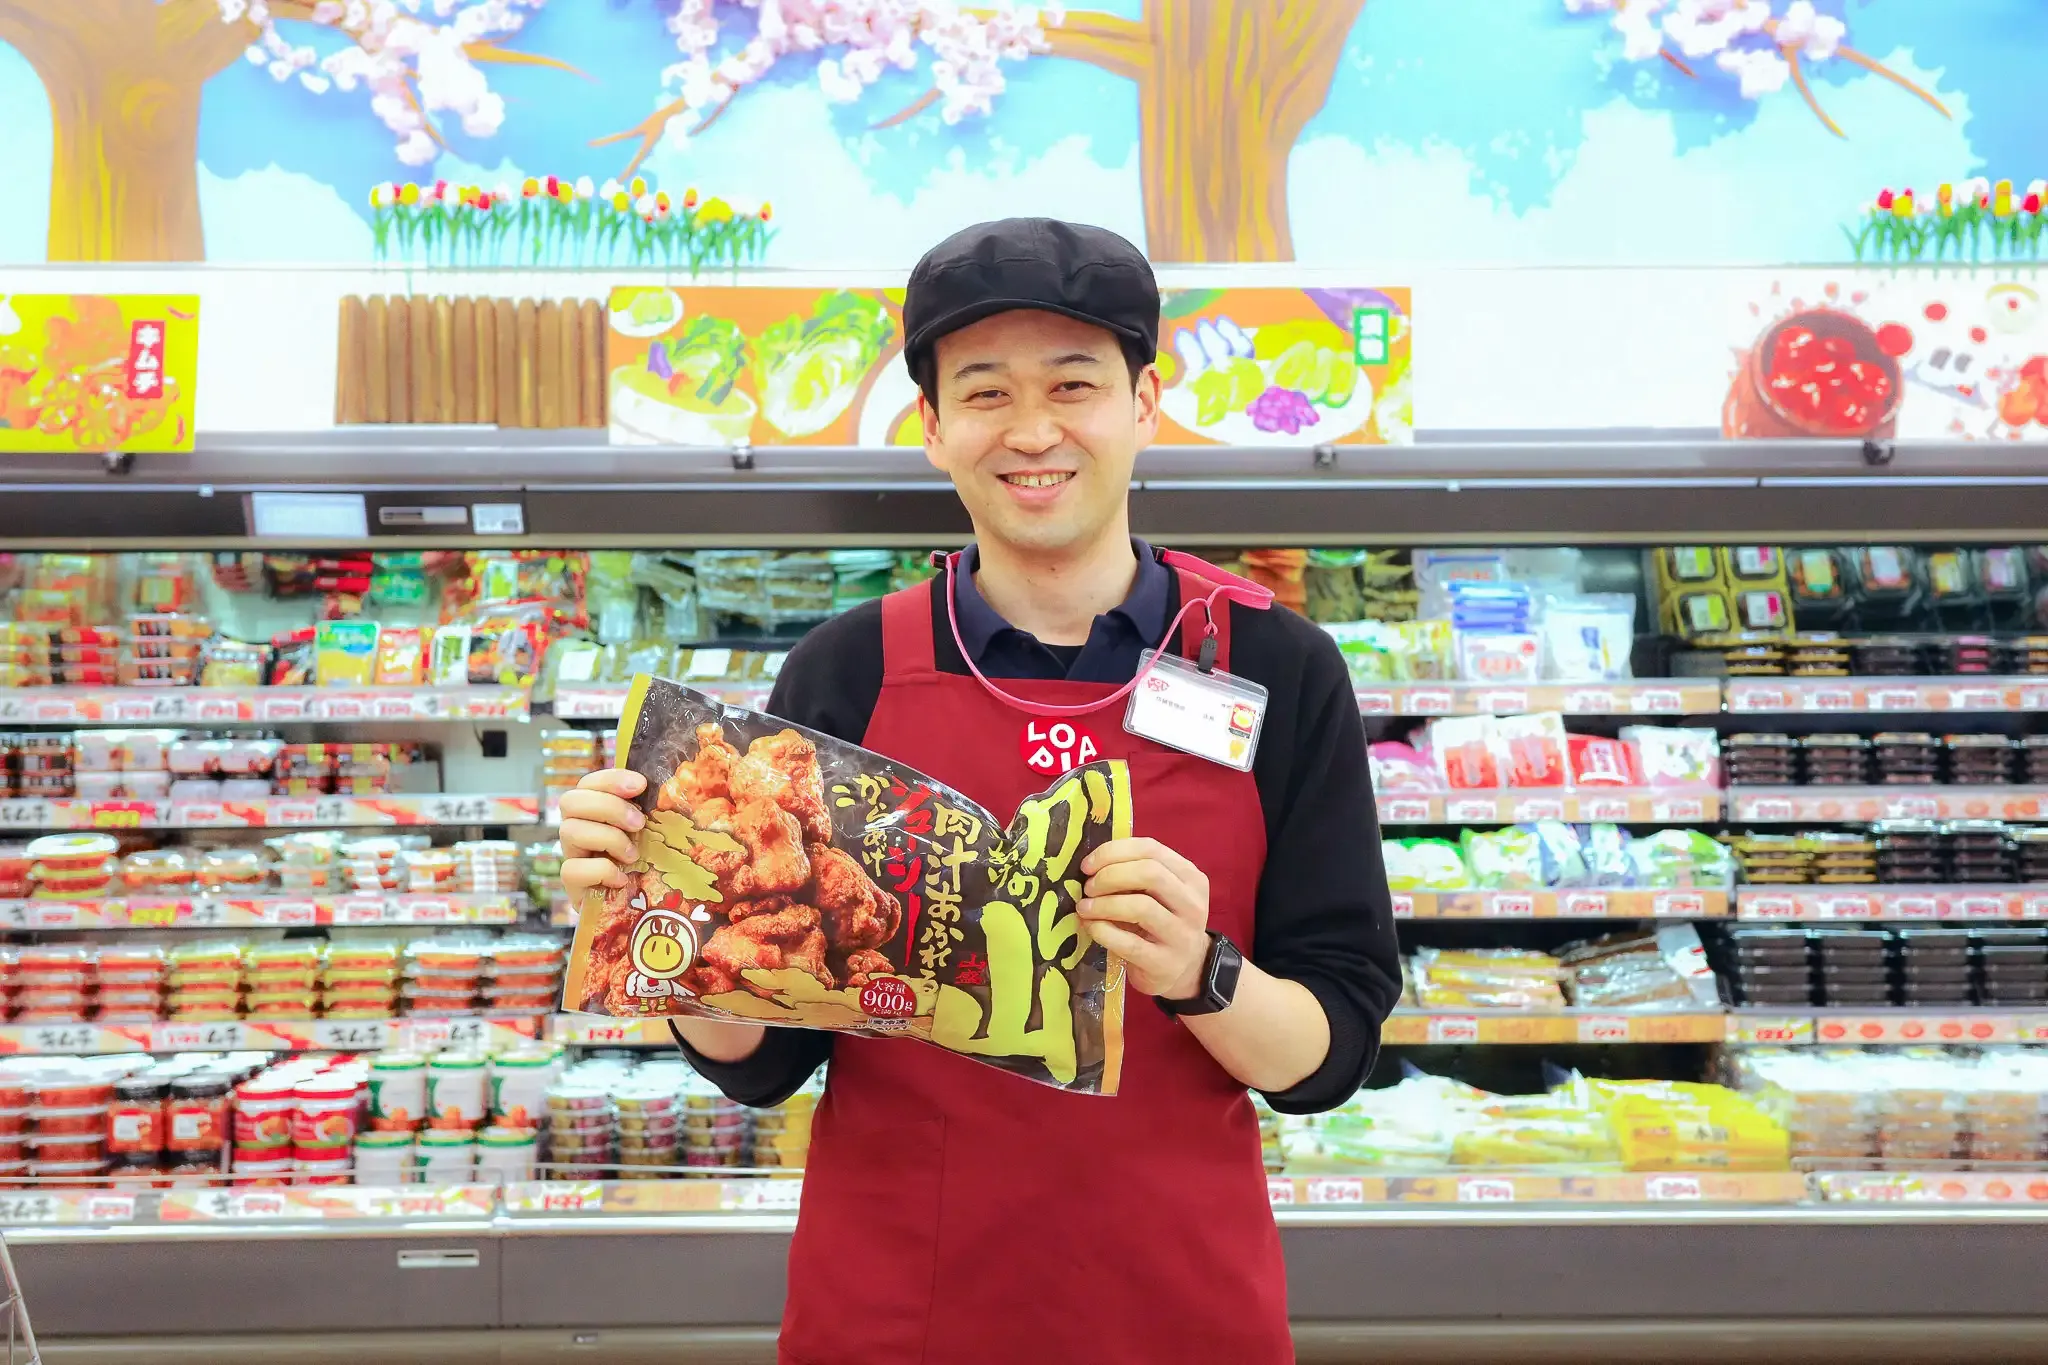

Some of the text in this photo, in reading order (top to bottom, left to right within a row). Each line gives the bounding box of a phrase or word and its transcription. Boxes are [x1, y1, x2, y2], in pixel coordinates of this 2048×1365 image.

[133, 323, 161, 394] キムチ
[917, 801, 983, 997] 肉汁あふれる
[863, 990, 913, 1012] 900g
[872, 980, 906, 994] 大容量
